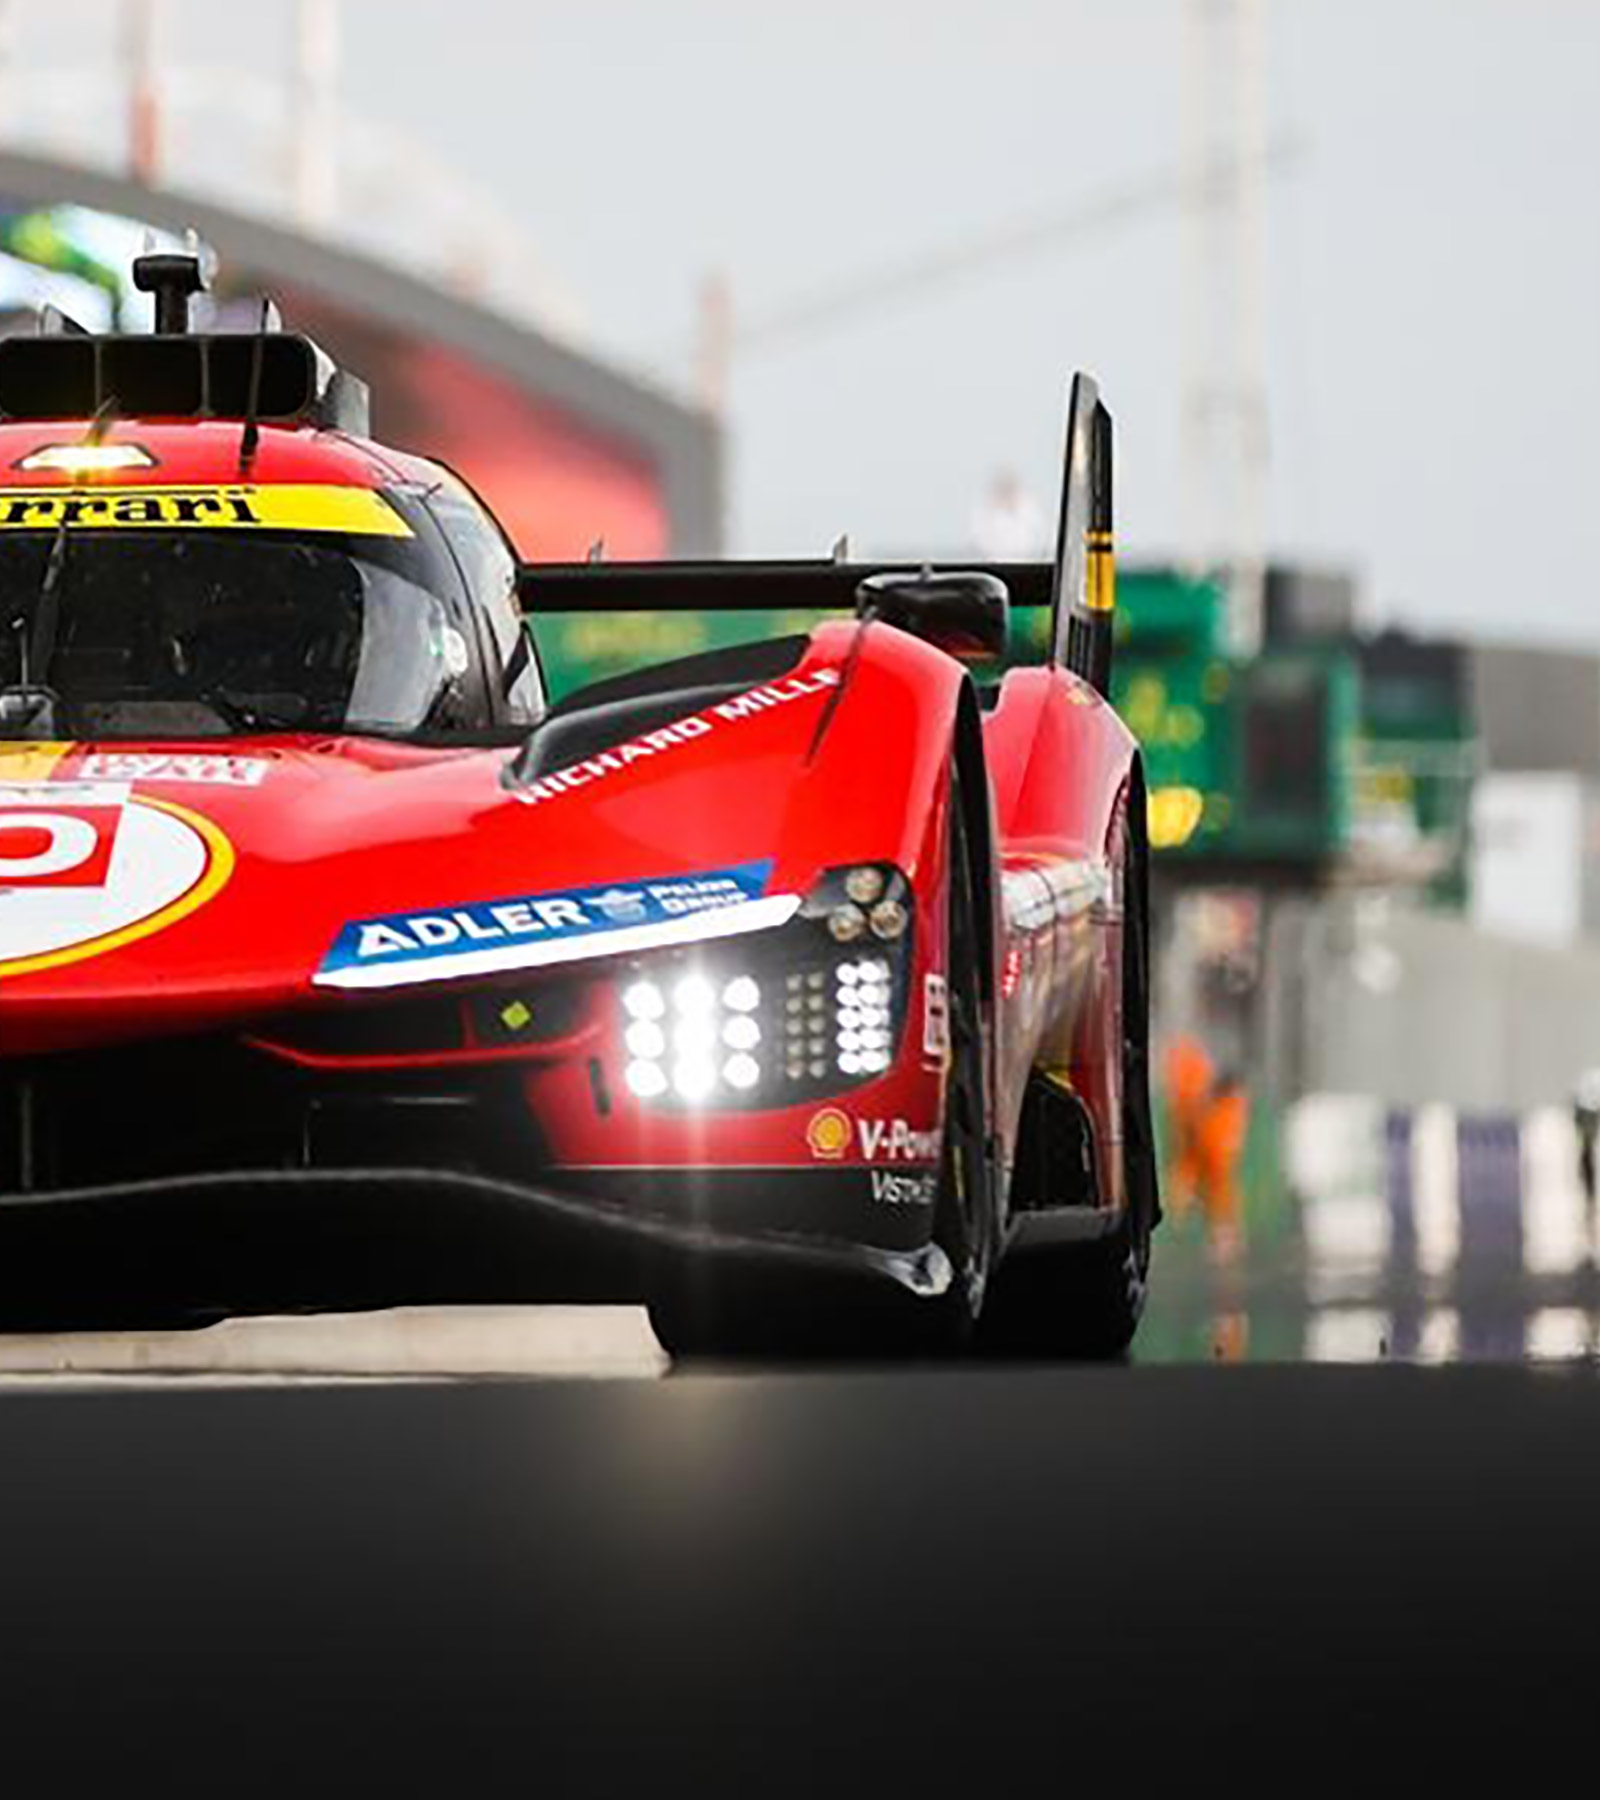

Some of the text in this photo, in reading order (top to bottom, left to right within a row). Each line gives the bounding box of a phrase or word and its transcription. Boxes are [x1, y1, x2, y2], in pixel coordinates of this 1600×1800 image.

[515, 667, 840, 805] RICHARD MILLE
[357, 896, 591, 957] ADLER
